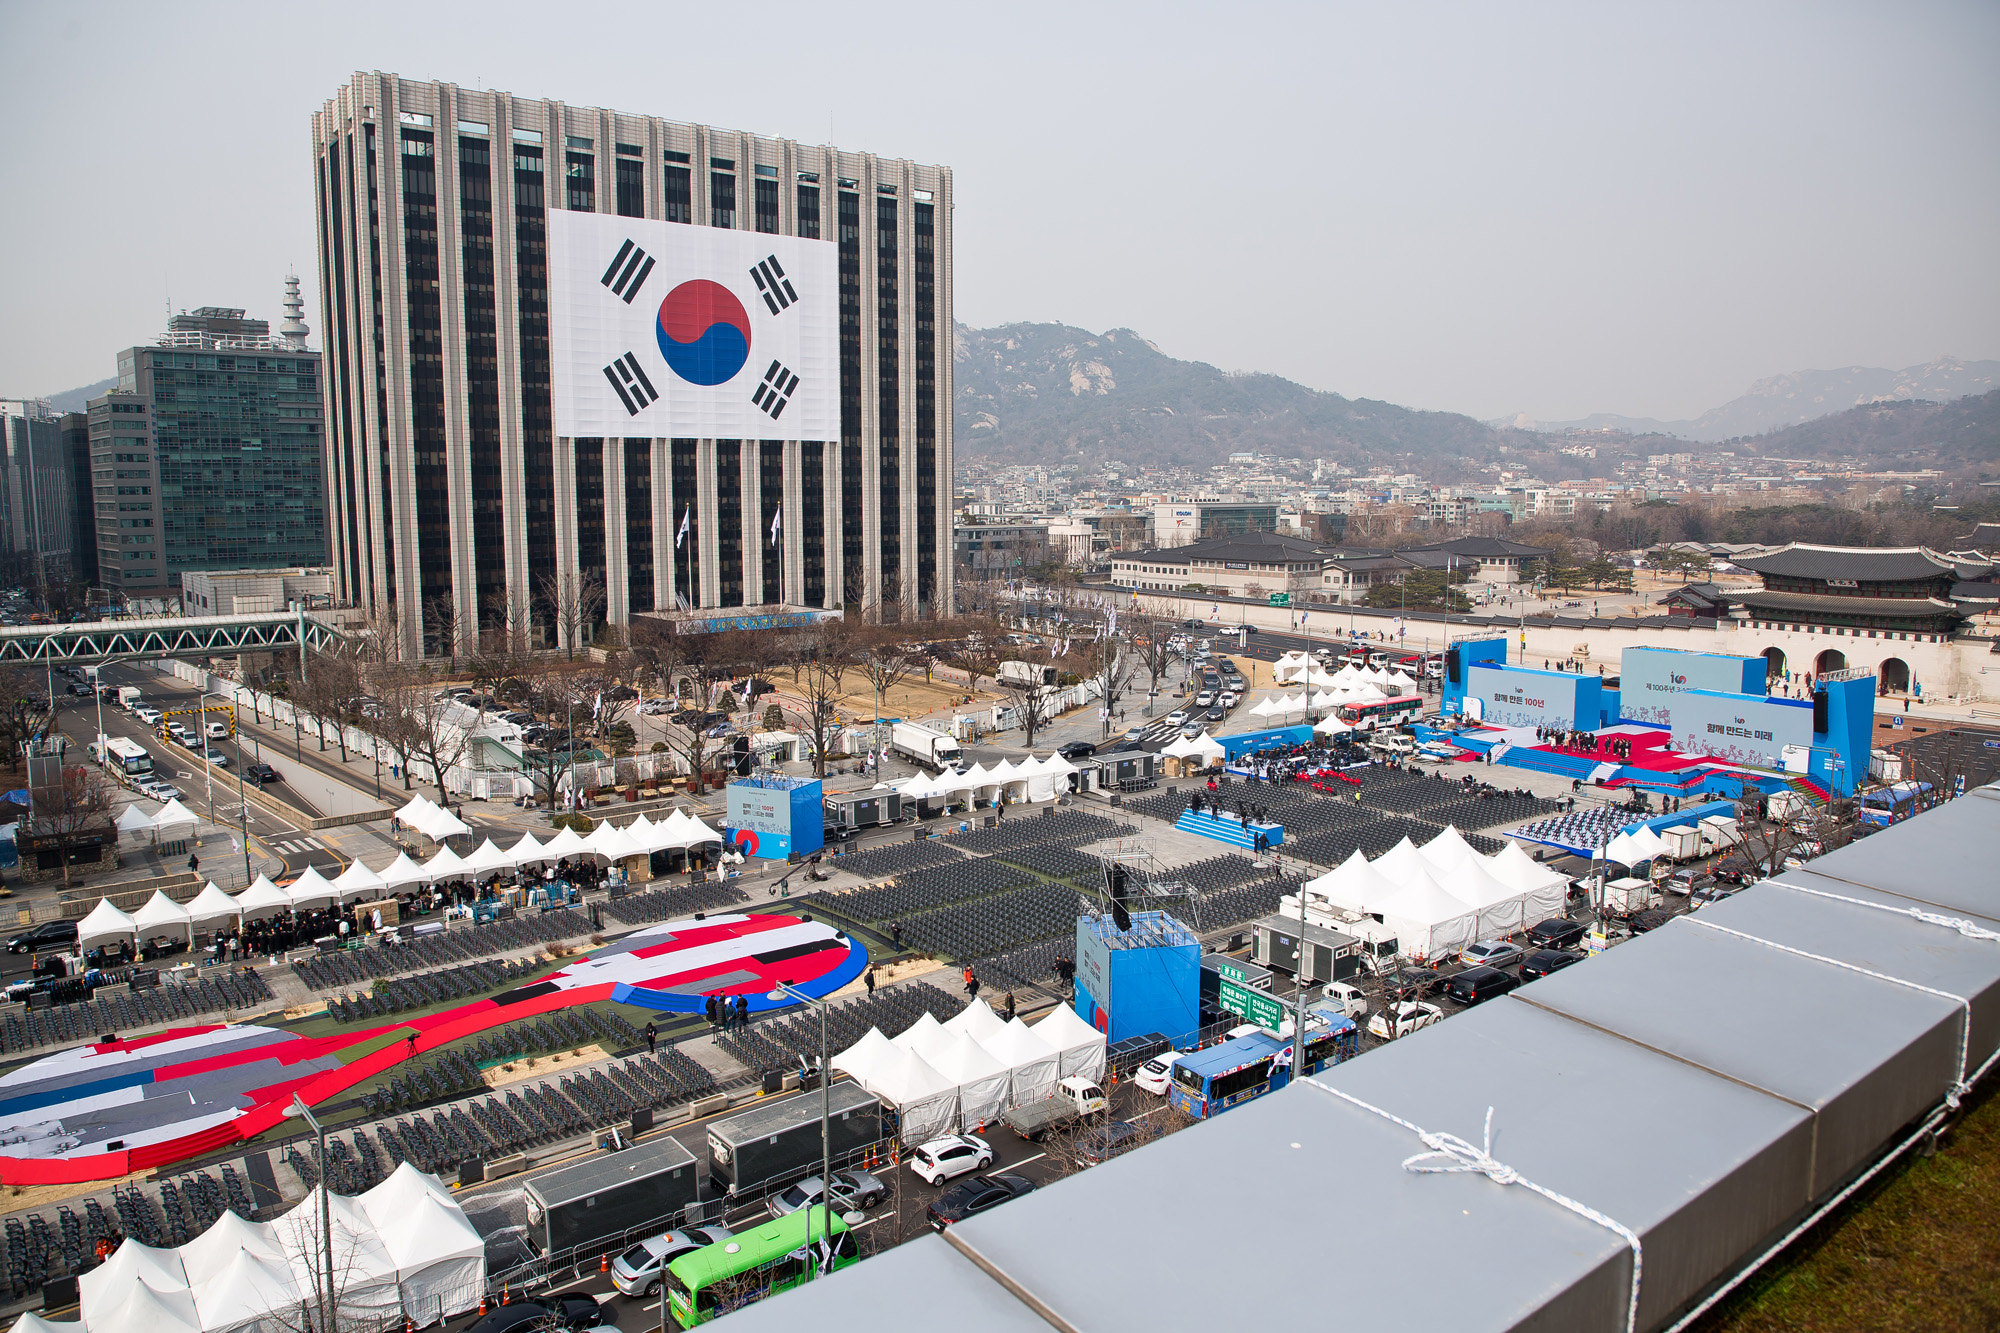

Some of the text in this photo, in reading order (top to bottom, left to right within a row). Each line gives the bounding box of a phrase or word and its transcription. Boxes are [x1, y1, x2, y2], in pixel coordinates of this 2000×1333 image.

[1494, 692, 1545, 708] 함께 만든 100년
[1707, 723, 1773, 742] 함께 만드는 미래
[1253, 999, 1277, 1015] 안국동사거리
